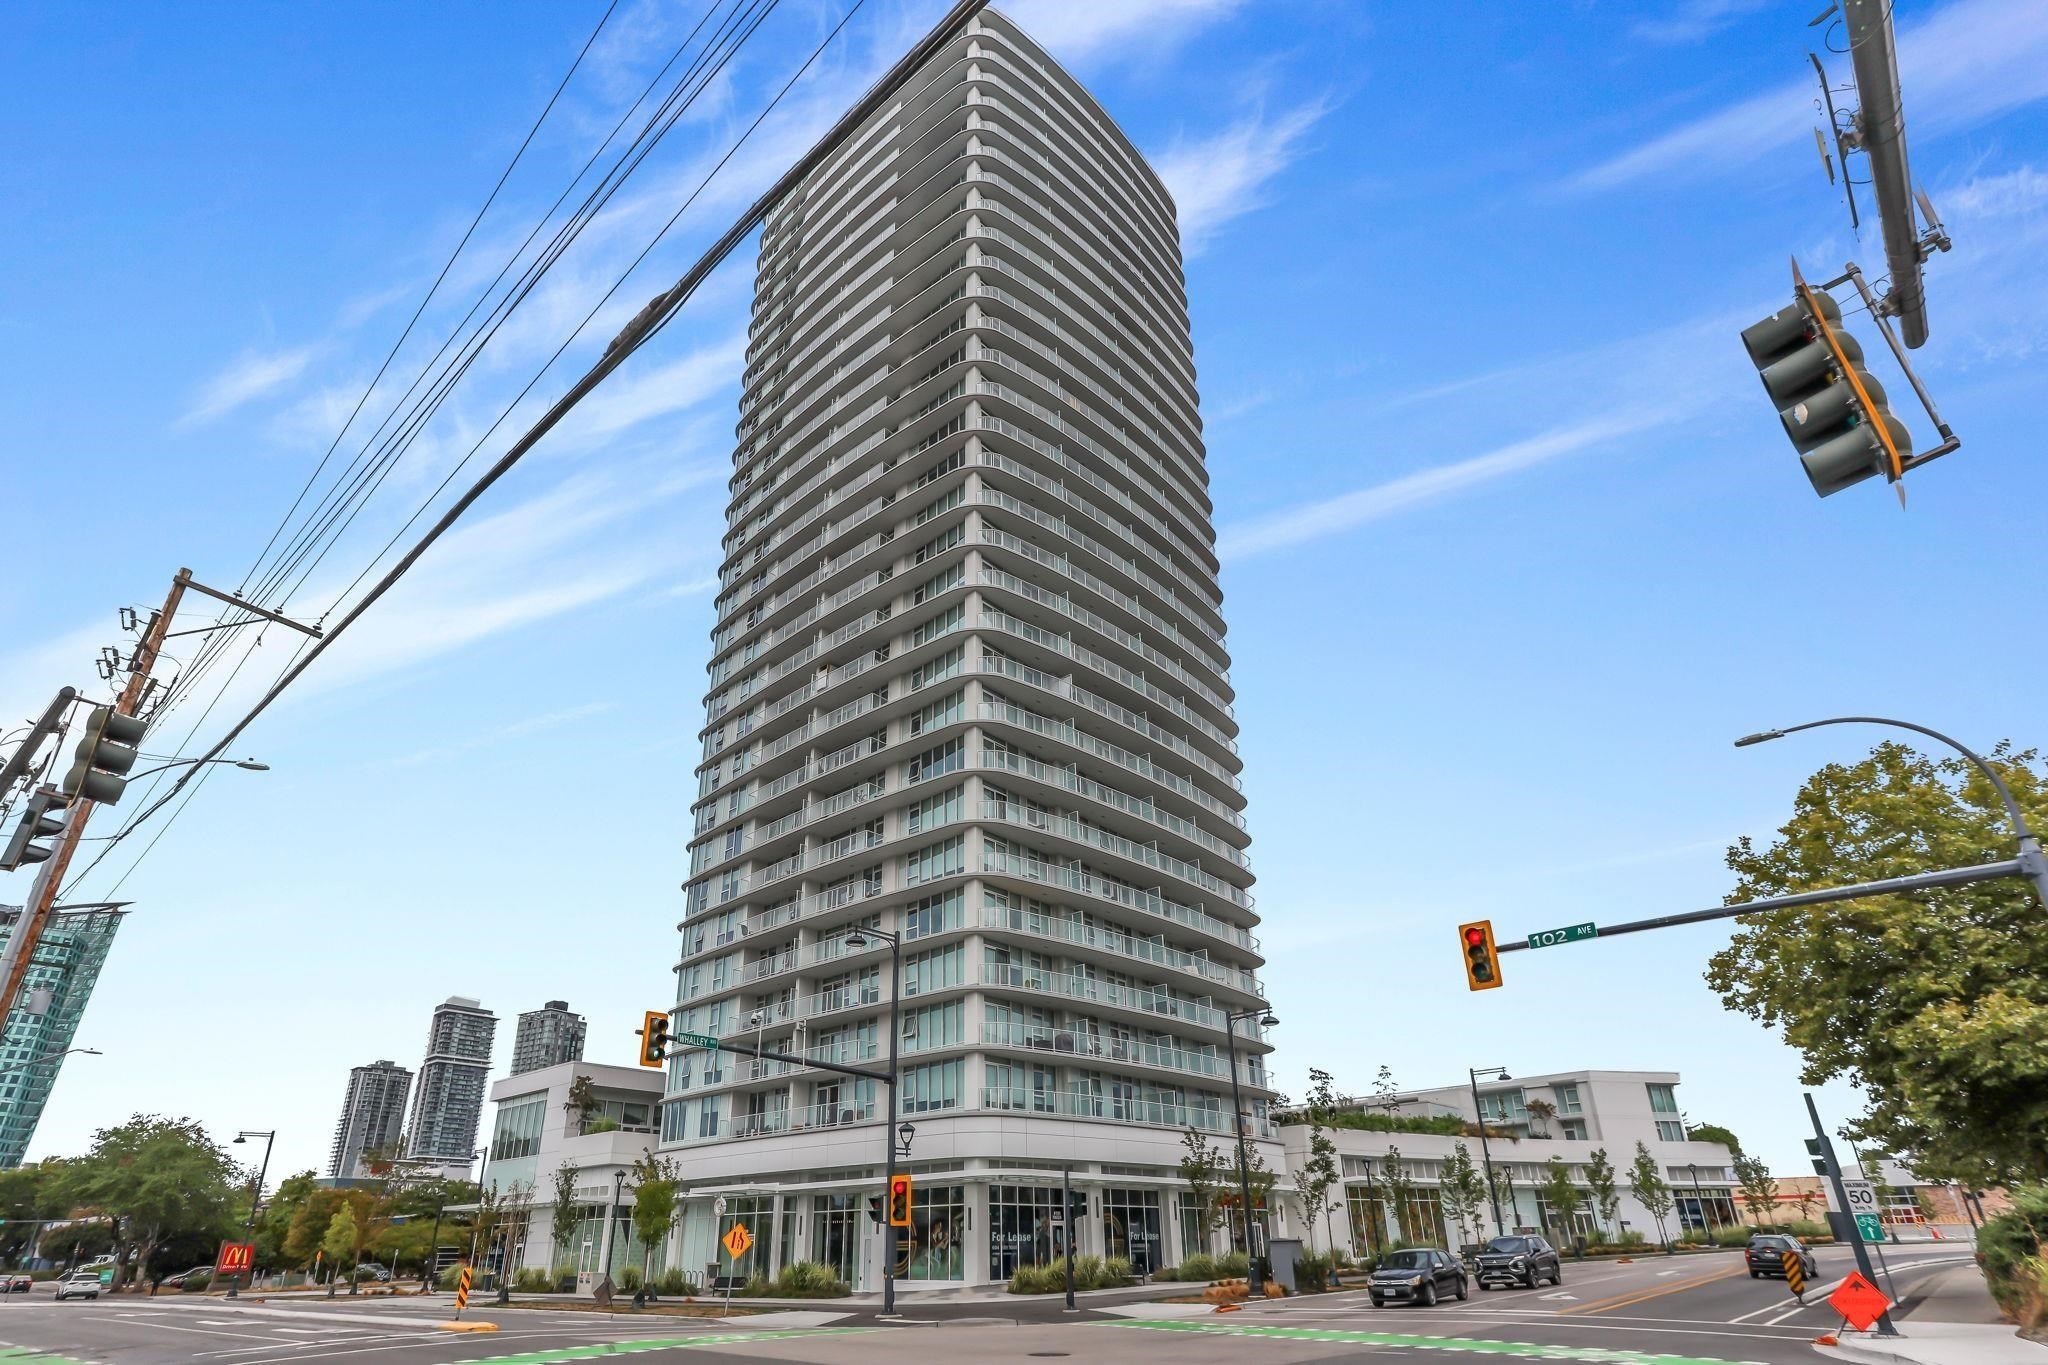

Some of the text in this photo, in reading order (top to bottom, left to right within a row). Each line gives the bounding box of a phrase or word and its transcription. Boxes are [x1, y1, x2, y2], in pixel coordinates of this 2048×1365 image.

[1533, 925, 1592, 947] 102 AVE
[679, 1034, 709, 1047] WHALLEY
[1849, 1190, 1872, 1204] 50
[991, 1231, 1006, 1242] For
[1130, 1231, 1159, 1241] For Lase
